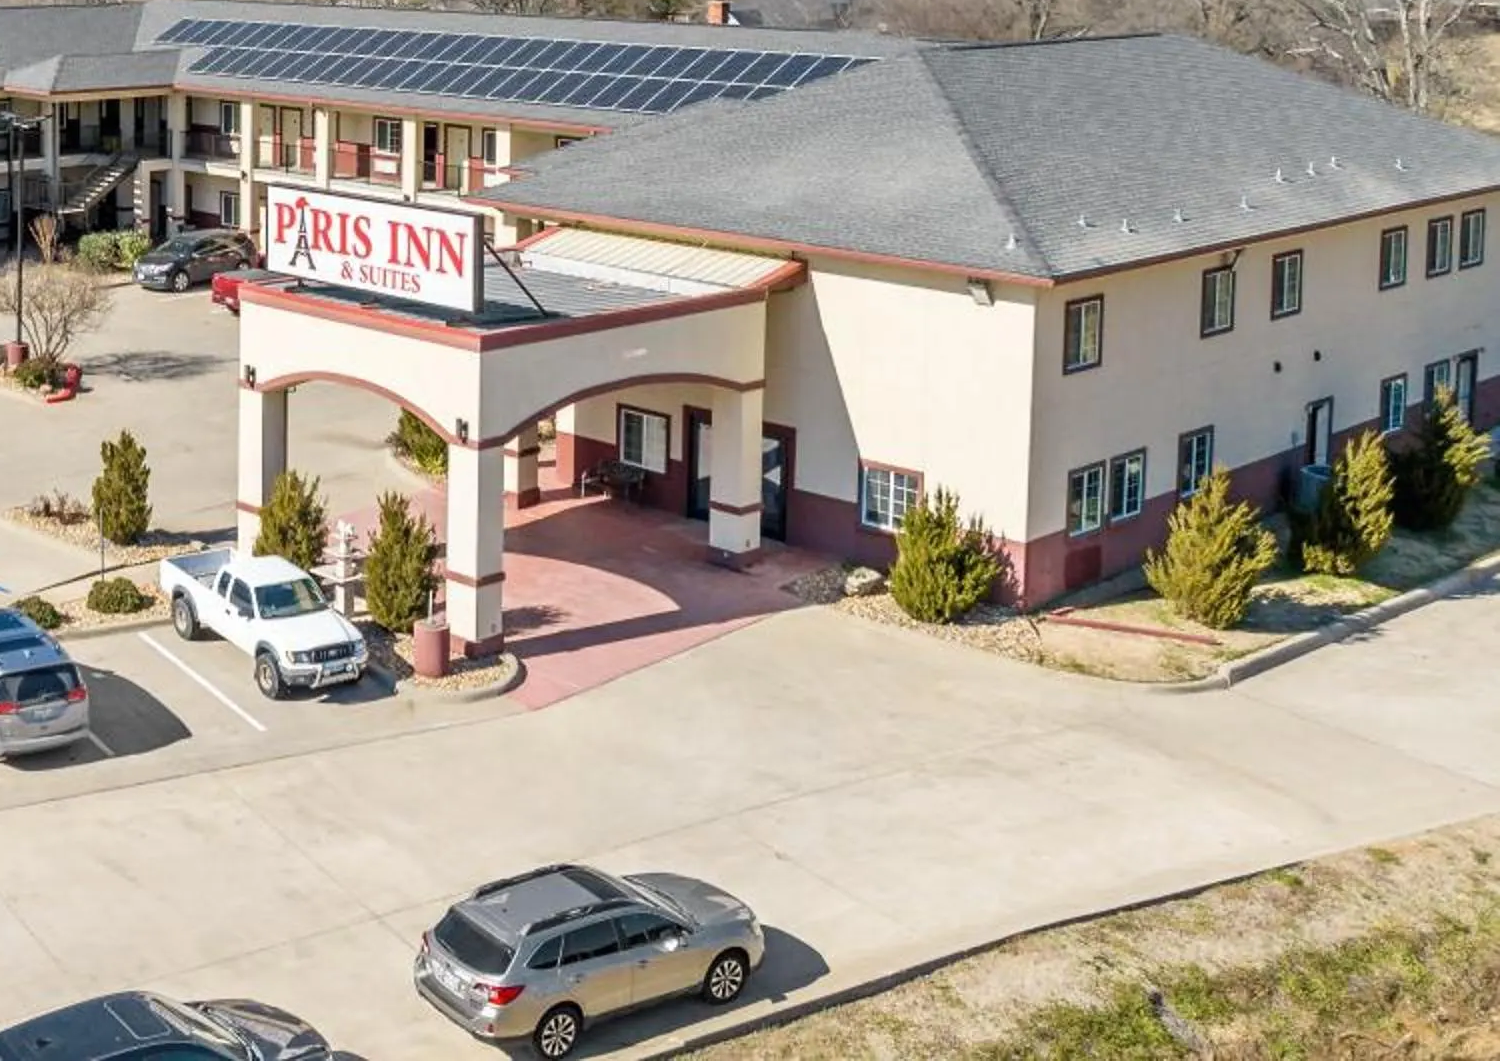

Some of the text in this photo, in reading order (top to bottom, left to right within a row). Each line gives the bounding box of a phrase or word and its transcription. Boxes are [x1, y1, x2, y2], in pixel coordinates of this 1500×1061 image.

[274, 198, 468, 278] PARIS INN
[341, 260, 421, 294] & SUITES
